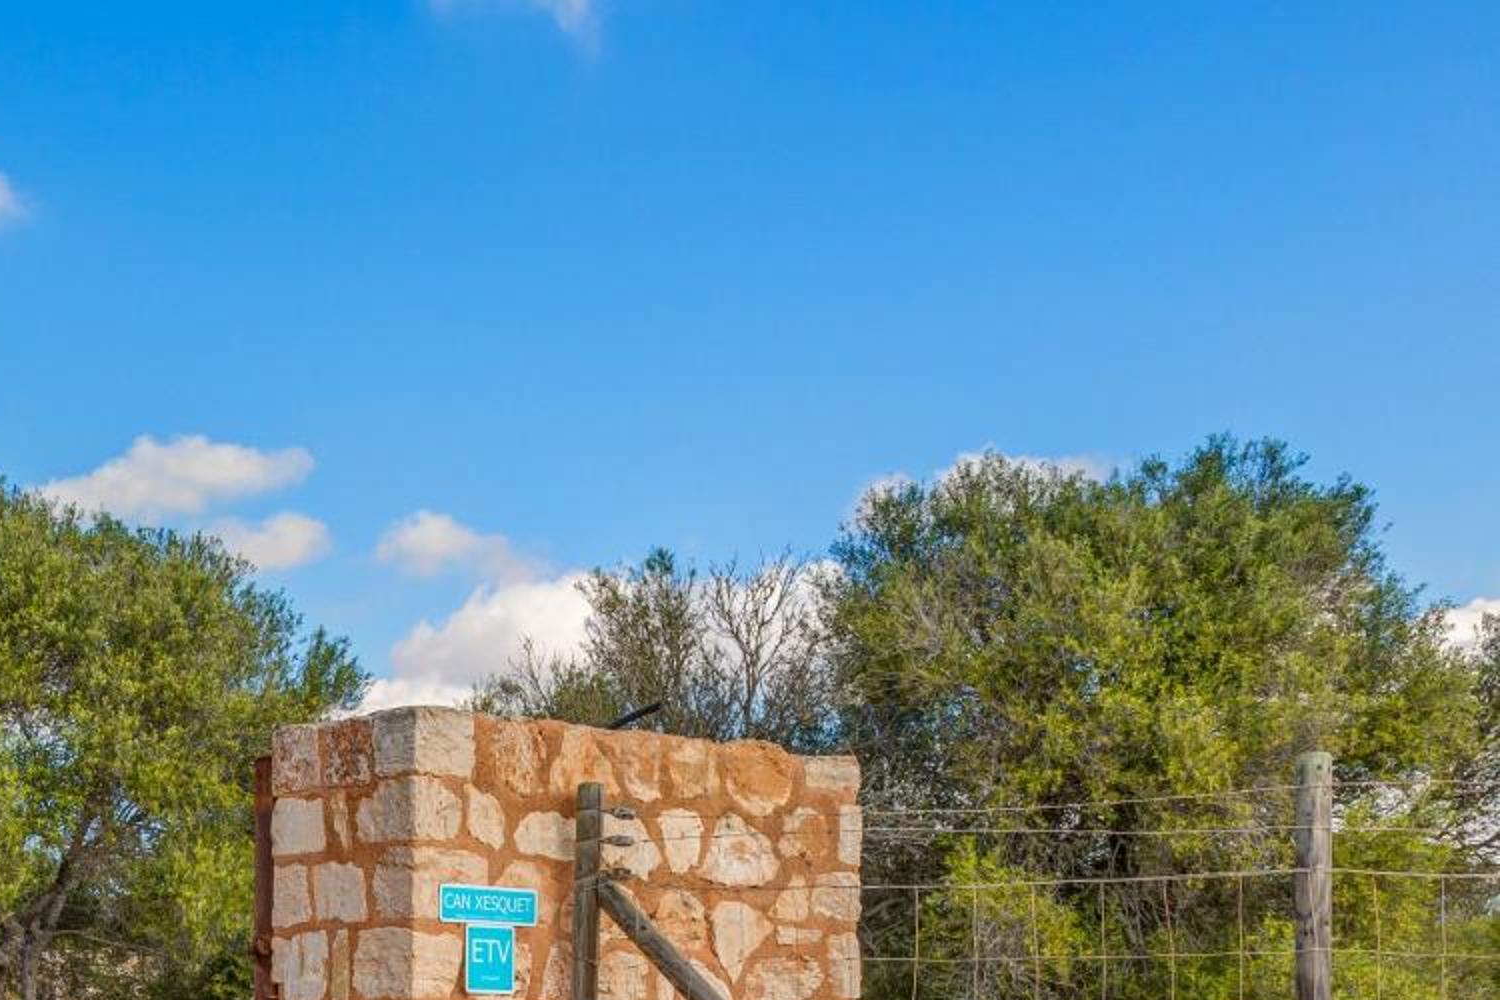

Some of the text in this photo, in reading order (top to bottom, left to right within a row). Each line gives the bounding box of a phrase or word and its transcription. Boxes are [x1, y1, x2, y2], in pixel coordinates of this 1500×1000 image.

[443, 893, 533, 914] CAN XESQUET
[471, 938, 510, 964] ETV
